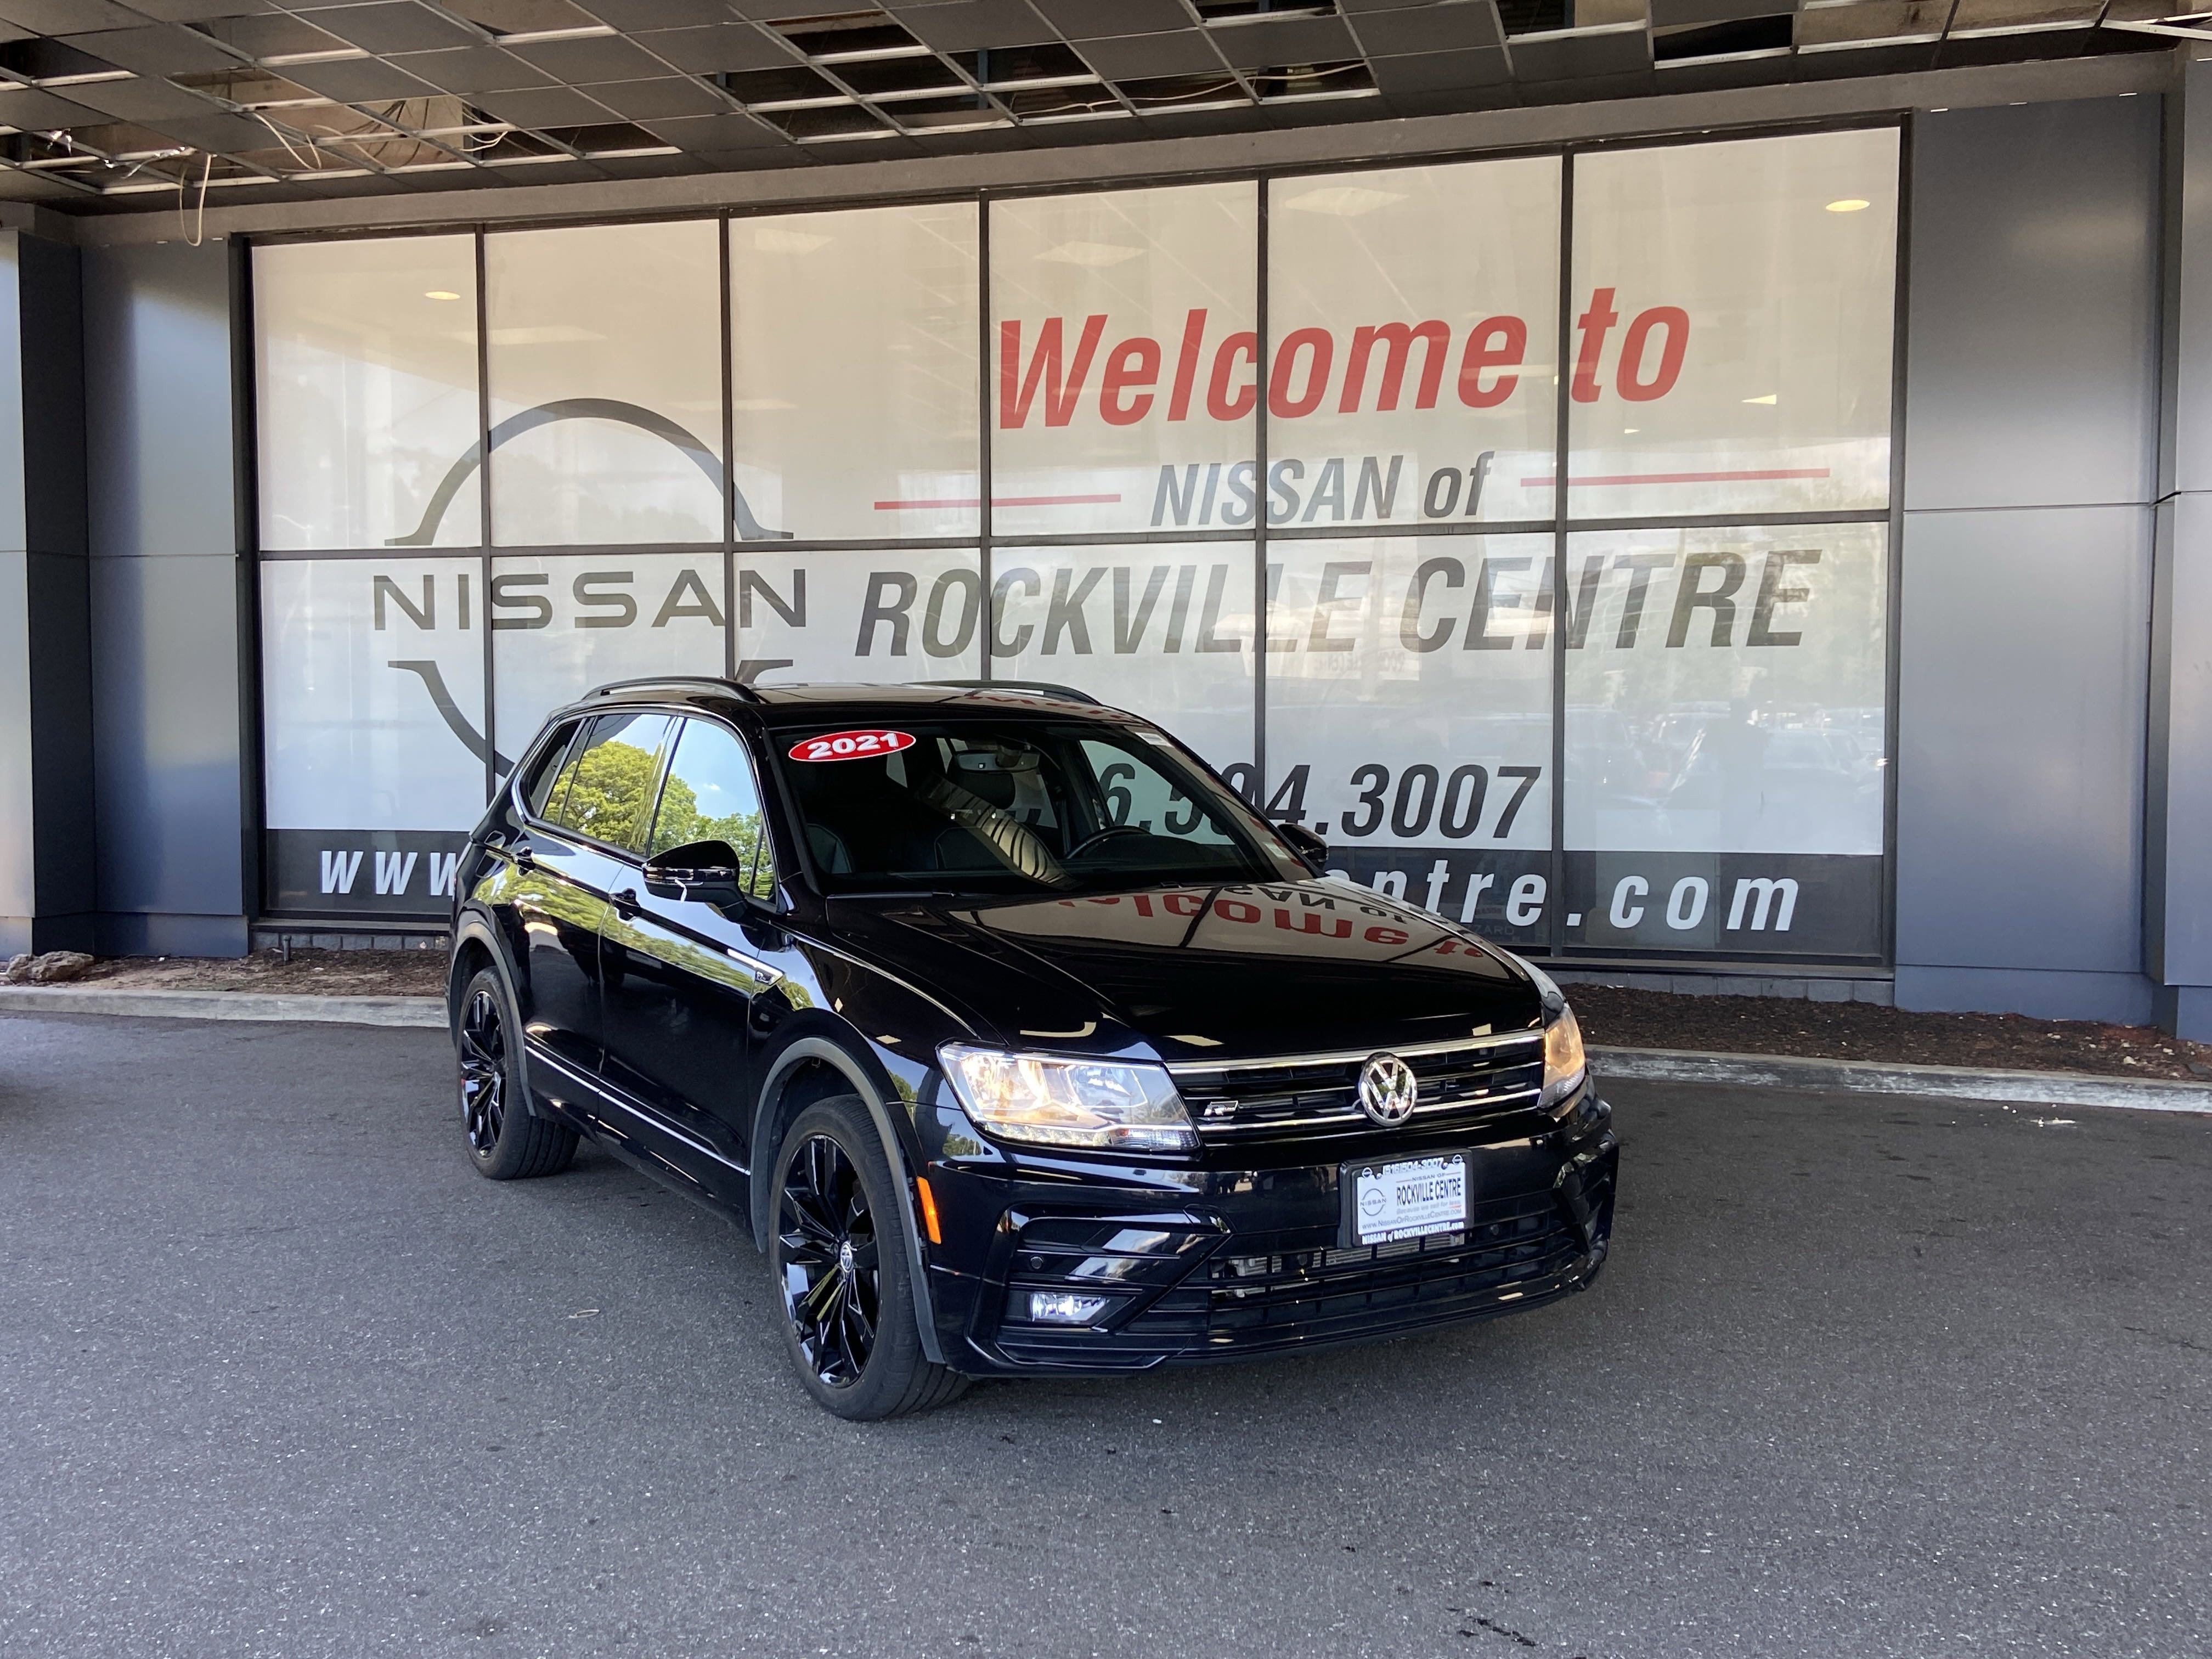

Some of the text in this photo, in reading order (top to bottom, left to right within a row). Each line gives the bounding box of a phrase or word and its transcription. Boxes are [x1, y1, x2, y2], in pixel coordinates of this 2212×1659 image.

[998, 287, 1690, 430] Welcome to
[1151, 451, 1494, 527] NISSAN of
[374, 569, 806, 630] NISSAN
[855, 549, 1822, 658] ROCKVILLE CENTRE
[807, 732, 900, 759] 2021
[1359, 1198, 1387, 1207] NISSAN
[1396, 1177, 1462, 1206] ROCKVILLE CENTRE
[1362, 1232, 1387, 1245] NISSAN
